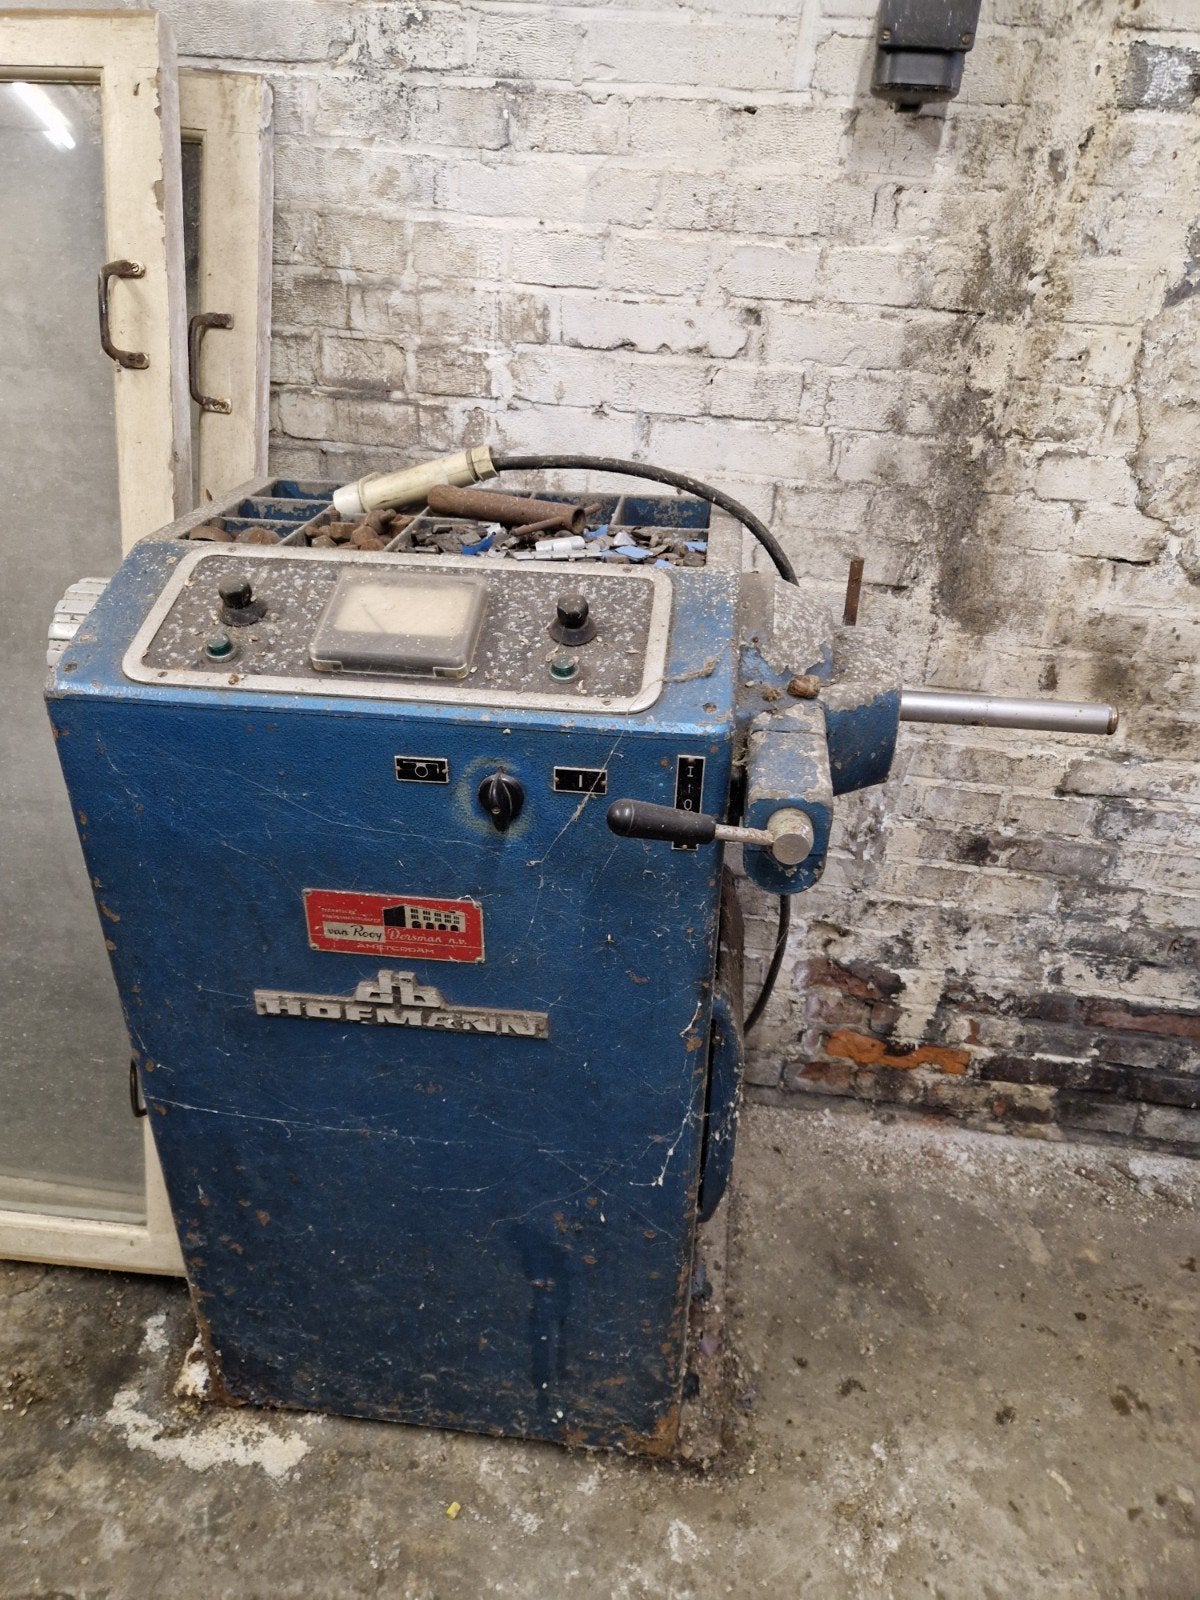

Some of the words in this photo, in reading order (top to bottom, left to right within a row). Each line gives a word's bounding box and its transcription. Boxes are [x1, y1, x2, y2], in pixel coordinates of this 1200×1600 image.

[326, 927, 349, 937] van
[350, 925, 382, 941] Rooy
[264, 999, 537, 1035] HOFMANN
